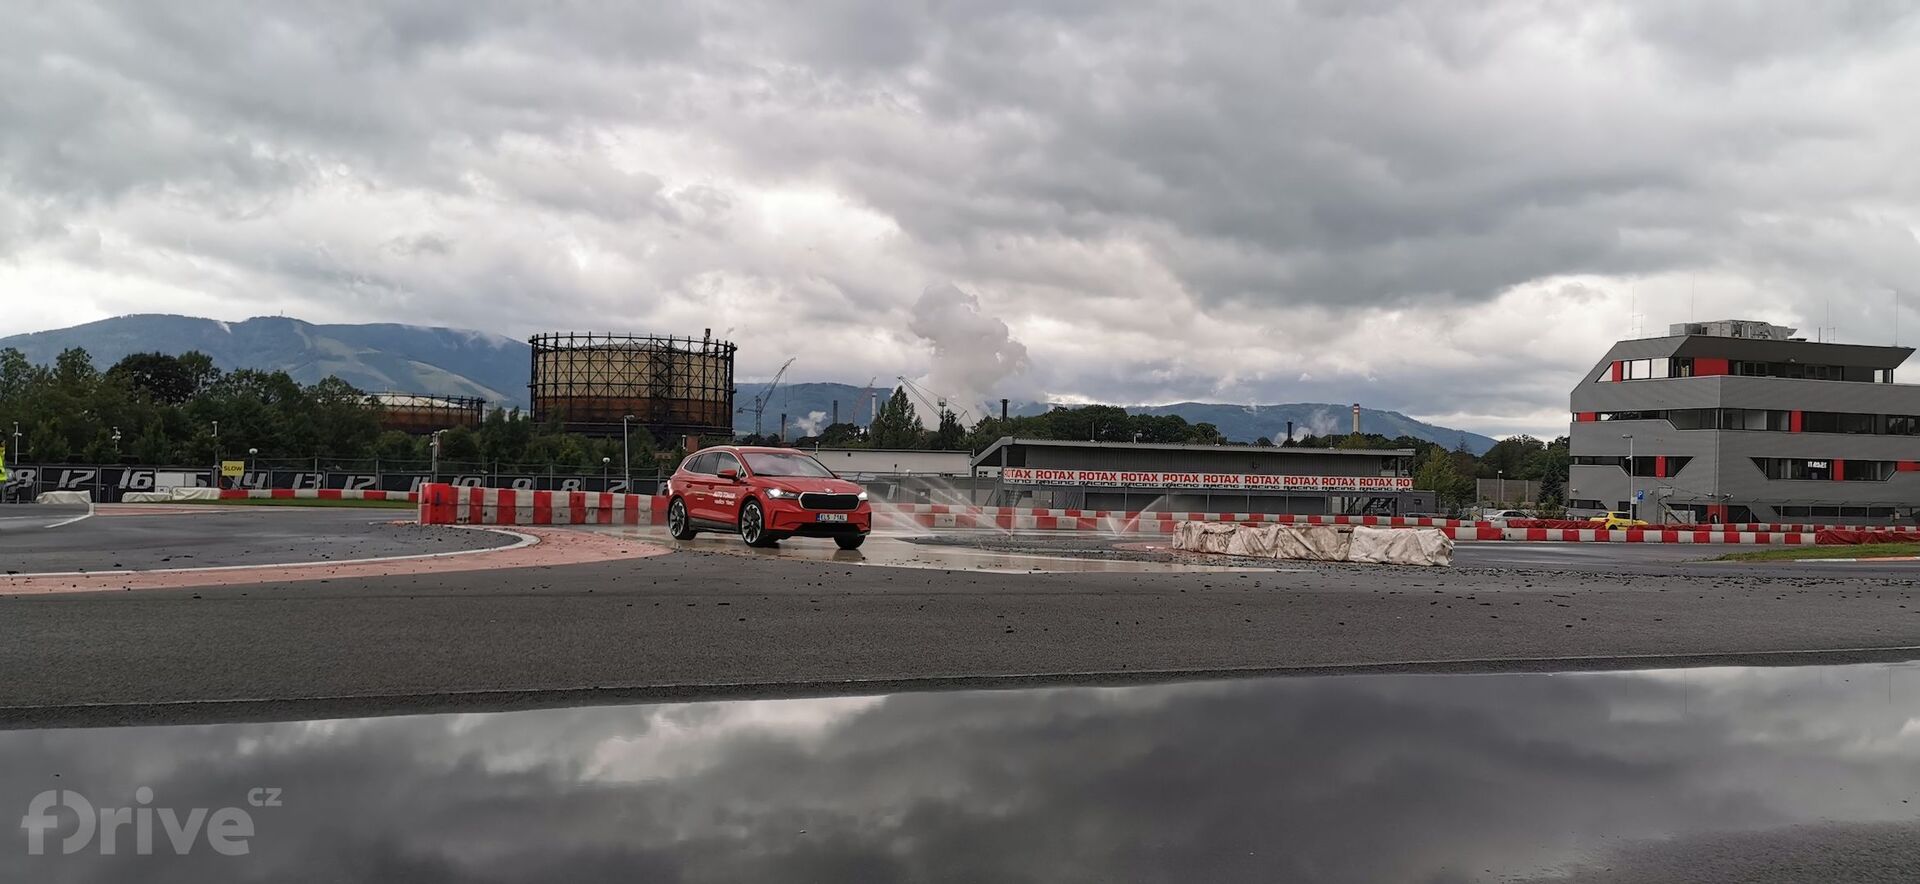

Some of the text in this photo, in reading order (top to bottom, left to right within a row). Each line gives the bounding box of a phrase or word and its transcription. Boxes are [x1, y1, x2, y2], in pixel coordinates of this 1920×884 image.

[118, 469, 154, 489] 16
[292, 473, 324, 490] 13
[1035, 470, 1074, 480] ROTAX
[1078, 471, 1117, 481] ROTAX
[1121, 473, 1158, 482] ROTAX
[1162, 474, 1199, 483] ROTAX
[1203, 474, 1239, 483] ROTAX
[1244, 475, 1280, 484] ROTAX
[1283, 476, 1318, 485] ROTAX
[1321, 477, 1355, 486] ROTAX
[1359, 478, 1392, 487] ROTAX
